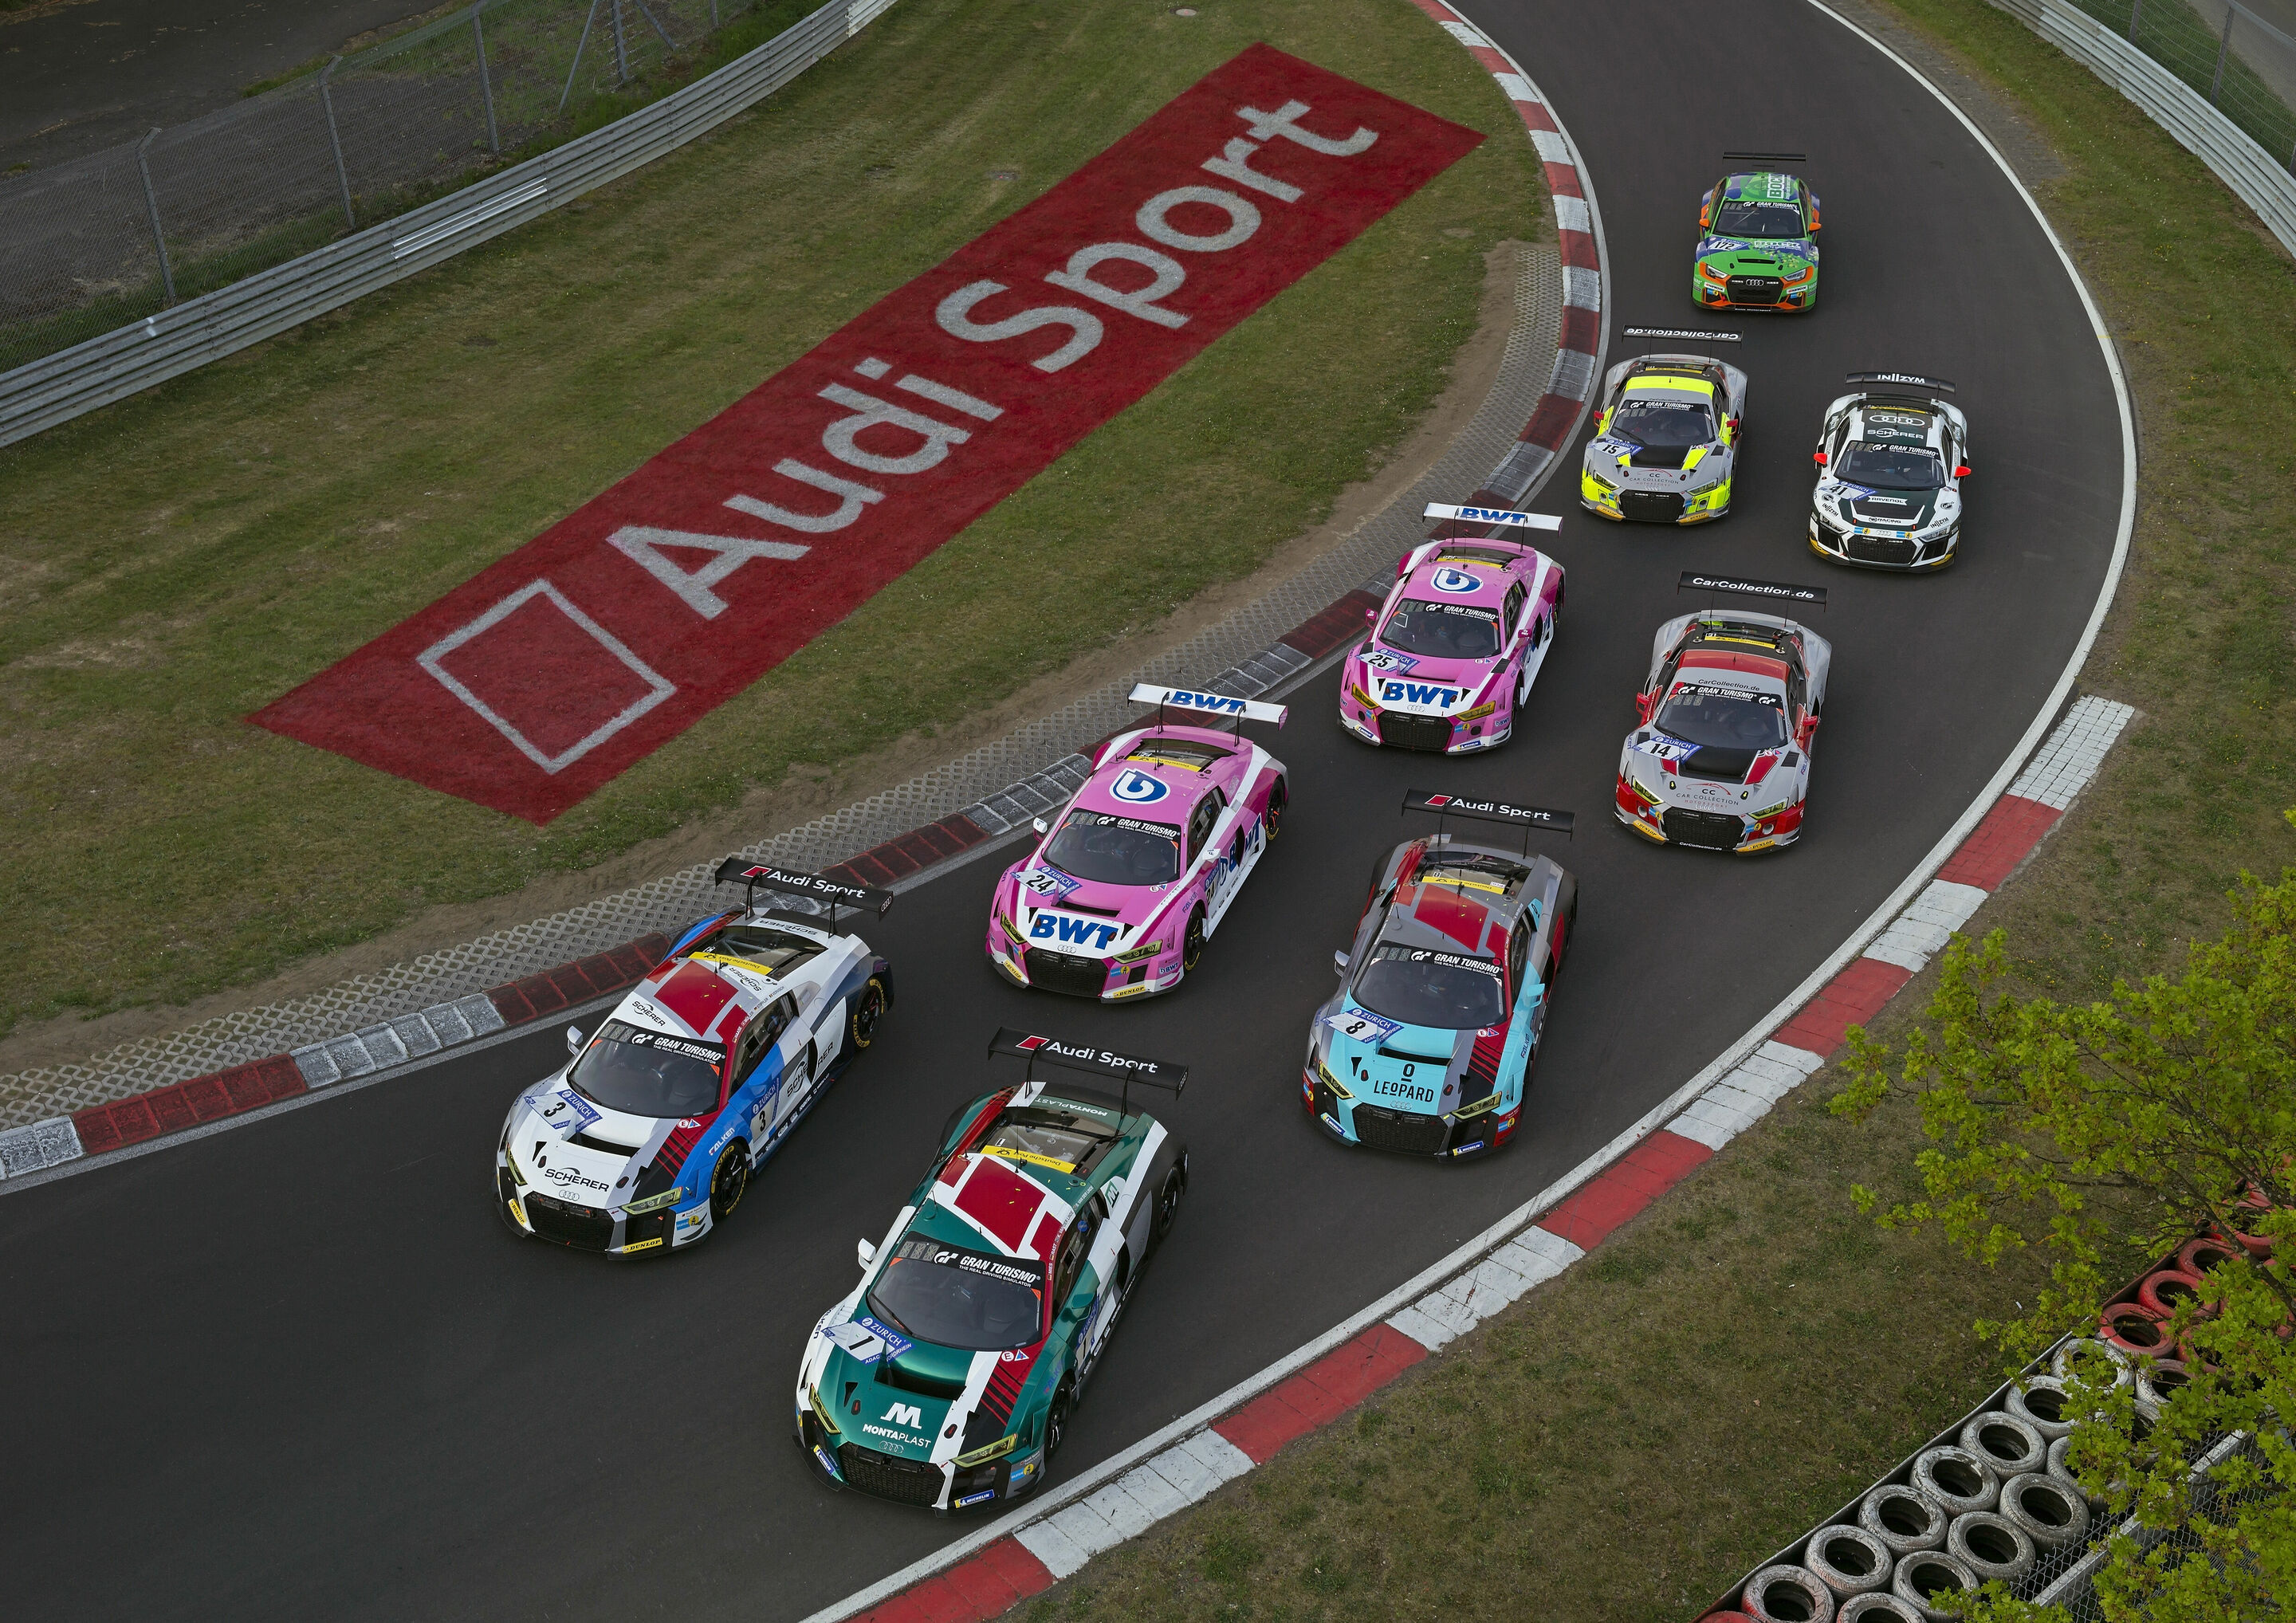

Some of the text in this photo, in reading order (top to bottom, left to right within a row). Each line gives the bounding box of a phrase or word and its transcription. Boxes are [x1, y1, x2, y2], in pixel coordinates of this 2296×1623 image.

[1714, 242, 1735, 250] 172
[607, 100, 1378, 619] Audi Sport
[1867, 428, 1924, 440] SCHERER
[1602, 444, 1620, 454] 15
[1829, 485, 1848, 496] 41
[1847, 482, 1869, 493] ZURICH
[1460, 508, 1526, 524] BWT
[1693, 577, 1814, 599] CarCollection.de
[1444, 605, 1464, 615] GRAN
[1368, 654, 1392, 668] 25
[1387, 650, 1410, 663] ZURICH
[1696, 686, 1720, 695] GRAN
[1698, 678, 1760, 691] CarCollection.de
[1170, 690, 1245, 713] BWT
[1382, 682, 1459, 709] BWT
[1649, 743, 1672, 757] 14
[1663, 738, 1692, 749] ZURICH
[1684, 800, 1728, 808] MOTORSPORT
[1693, 794, 1739, 806] COLLECTION
[1451, 798, 1551, 820] Audi Sport
[1117, 818, 1142, 828] GRAN
[1639, 823, 1657, 836] DUNLOP
[1679, 841, 1722, 851] CarCollection.de
[1752, 839, 1773, 849] DUNLOP
[767, 870, 866, 898] Audi Sport
[1026, 874, 1055, 892] 24
[1048, 869, 1071, 886] ZURICH
[759, 920, 818, 936] SCHERER
[1029, 914, 1119, 949] BWT
[733, 958, 761, 969] Deutsche
[1434, 953, 1460, 965] GRAN
[1007, 964, 1022, 980] DUNLOP
[1166, 962, 1179, 973] BWT
[1472, 967, 1497, 977] SIMULATOR
[729, 967, 761, 992] SCHERER
[1119, 986, 1145, 996] DUNLOP
[631, 1000, 666, 1027] SCHERER
[1361, 1012, 1391, 1028] ZURICH
[1346, 1021, 1366, 1035] 8
[655, 1037, 680, 1049] GRAN
[673, 1049, 690, 1058] DRIVING
[691, 1054, 717, 1065] SIMULATOR
[1045, 1041, 1158, 1074] Audi Sport
[758, 1083, 776, 1107] ZURICH
[1374, 1080, 1434, 1102] LEOPARD
[543, 1102, 567, 1118] 3
[568, 1095, 592, 1117] ZURICH
[1035, 1096, 1108, 1117] MONTAPLAST
[759, 1110, 766, 1132] 3
[1327, 1118, 1343, 1134] MICHELIN
[708, 1126, 735, 1156] FALKEN
[1029, 1153, 1061, 1166] Deutsche
[545, 1167, 610, 1193] SCHERER
[511, 1204, 525, 1224] DUNLOP
[629, 1239, 661, 1252] DUNLOP
[960, 1256, 989, 1271] GRAN
[982, 1270, 1002, 1279] DRIVING
[1003, 1275, 1032, 1287] SIMULATOR
[871, 1322, 902, 1346] ZURICH
[848, 1335, 875, 1351] 1
[865, 1355, 880, 1364] ADAC
[863, 1423, 931, 1448] MONTAPLAST
[818, 1454, 834, 1473] MICHELIN
[966, 1492, 990, 1503] MICHELIN
